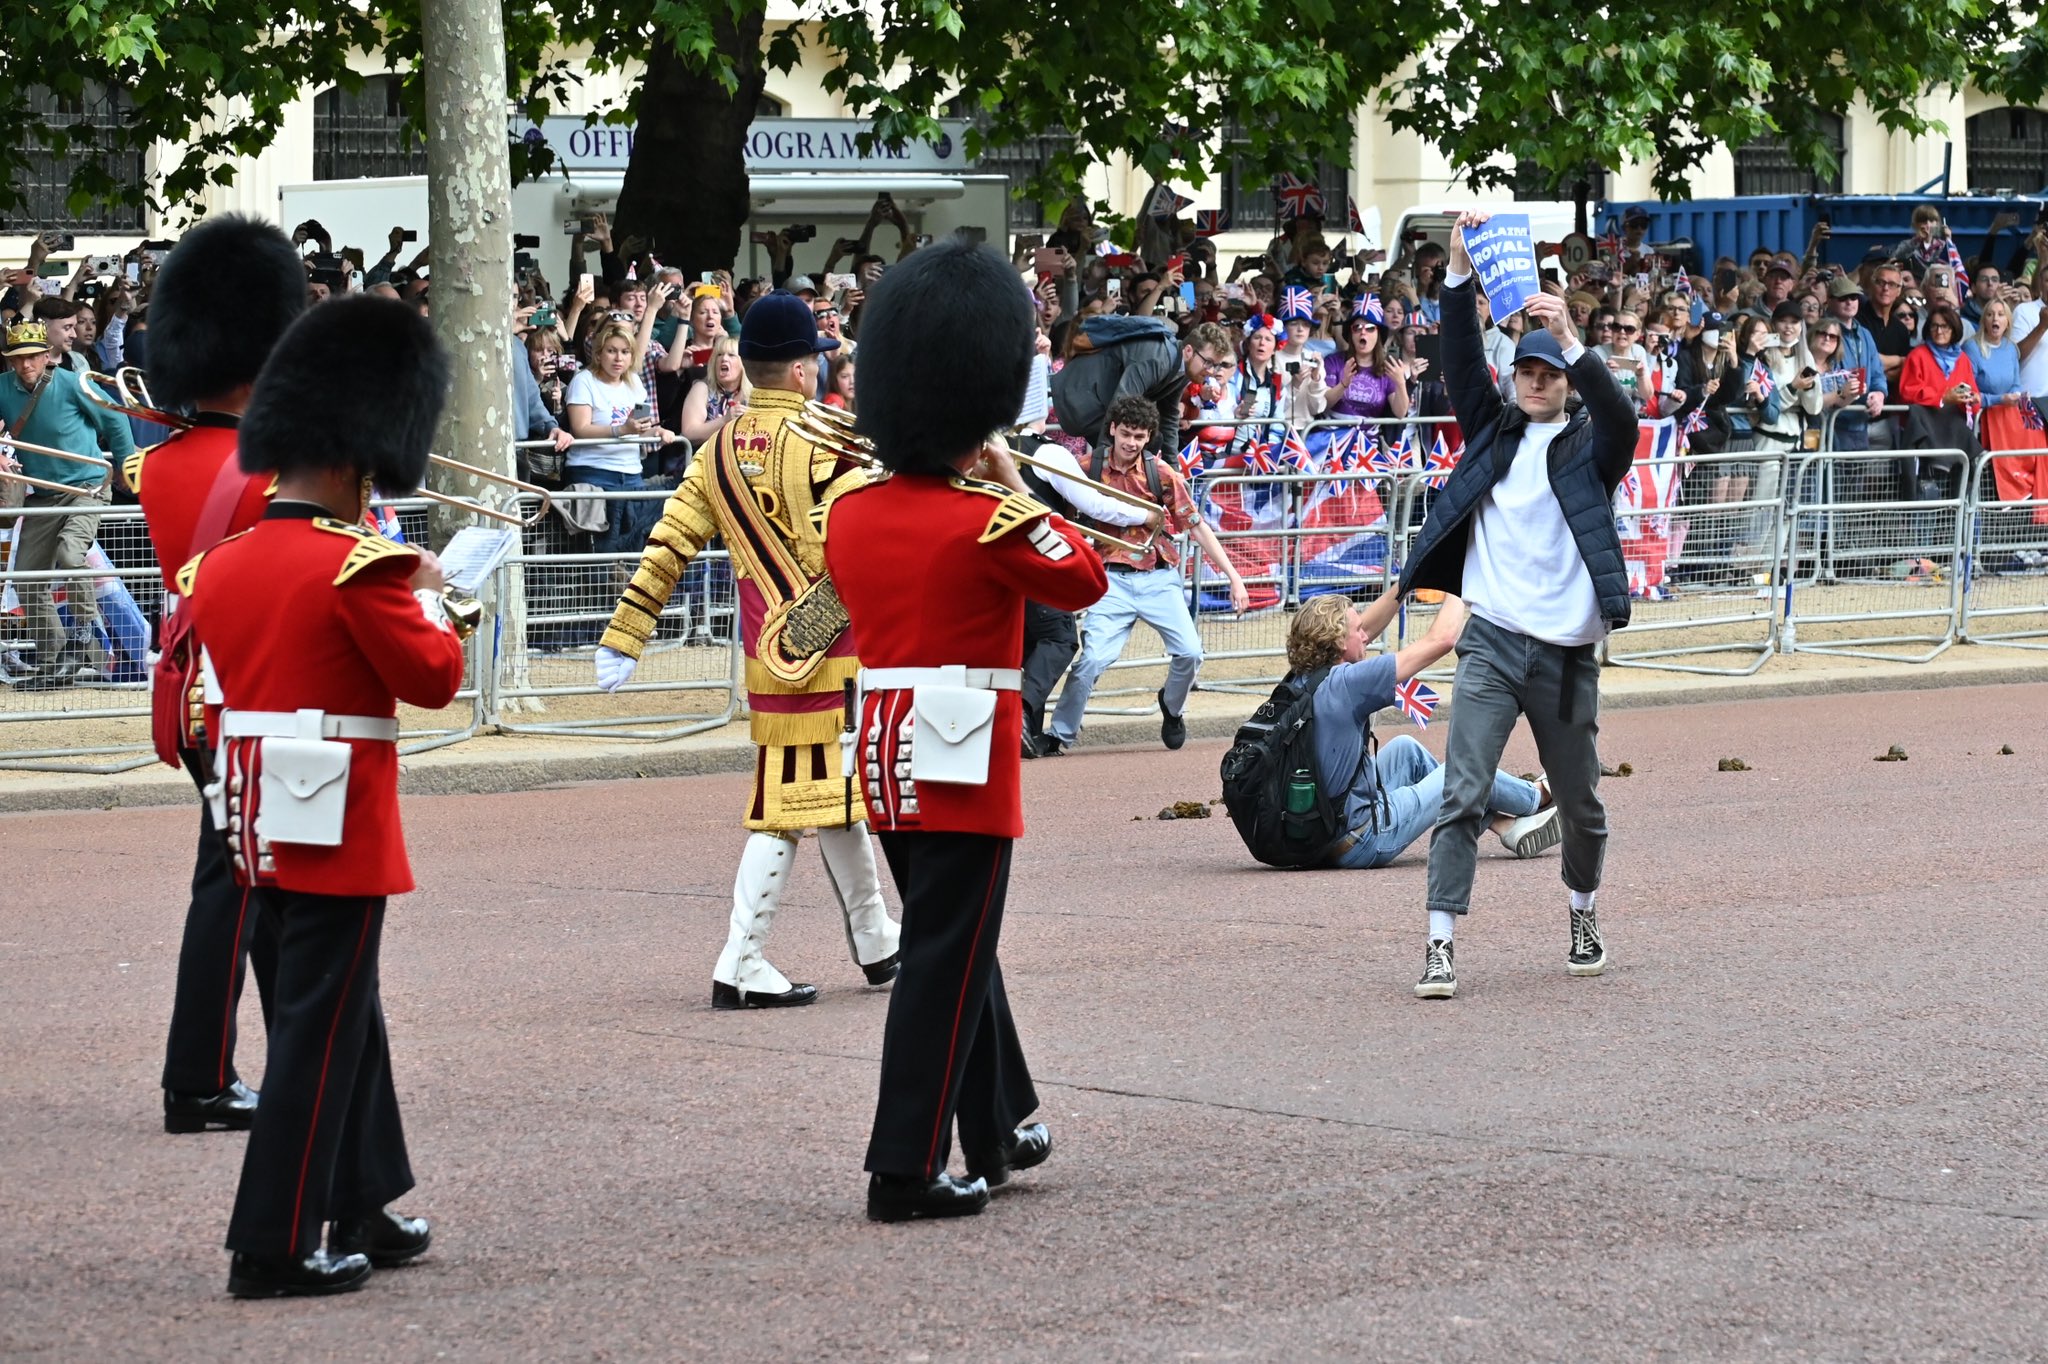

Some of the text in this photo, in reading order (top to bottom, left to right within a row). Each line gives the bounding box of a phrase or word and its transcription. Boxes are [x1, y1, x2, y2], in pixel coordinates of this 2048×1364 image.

[569, 129, 911, 159] OFFI ROGRAMME
[1467, 227, 1528, 249] RECLAIM
[1473, 241, 1530, 266] ROYAL
[1567, 246, 1583, 262] 10
[1482, 257, 1531, 285] LAND
